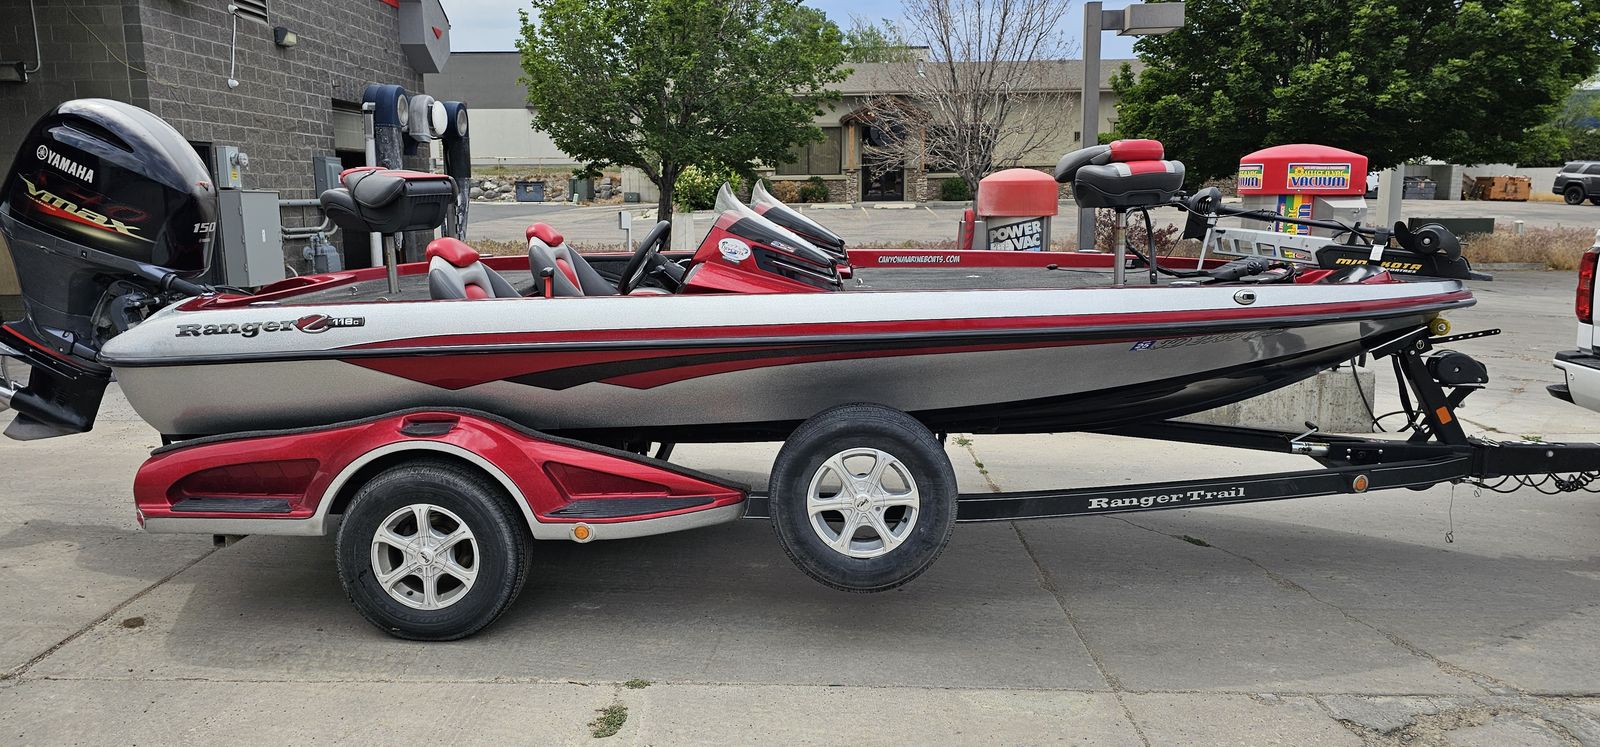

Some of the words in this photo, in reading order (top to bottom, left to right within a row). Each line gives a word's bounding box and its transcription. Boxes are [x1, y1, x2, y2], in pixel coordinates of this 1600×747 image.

[47, 150, 94, 184] YAMAHA
[1291, 176, 1346, 187] VACUUM
[193, 222, 216, 233] 150
[990, 220, 1042, 243] POWER
[1011, 233, 1041, 250] VAC
[1380, 261, 1423, 271] KOTA
[175, 318, 297, 338] Ranger
[1087, 493, 1184, 510] Ranger
[1186, 487, 1246, 500] Trail
